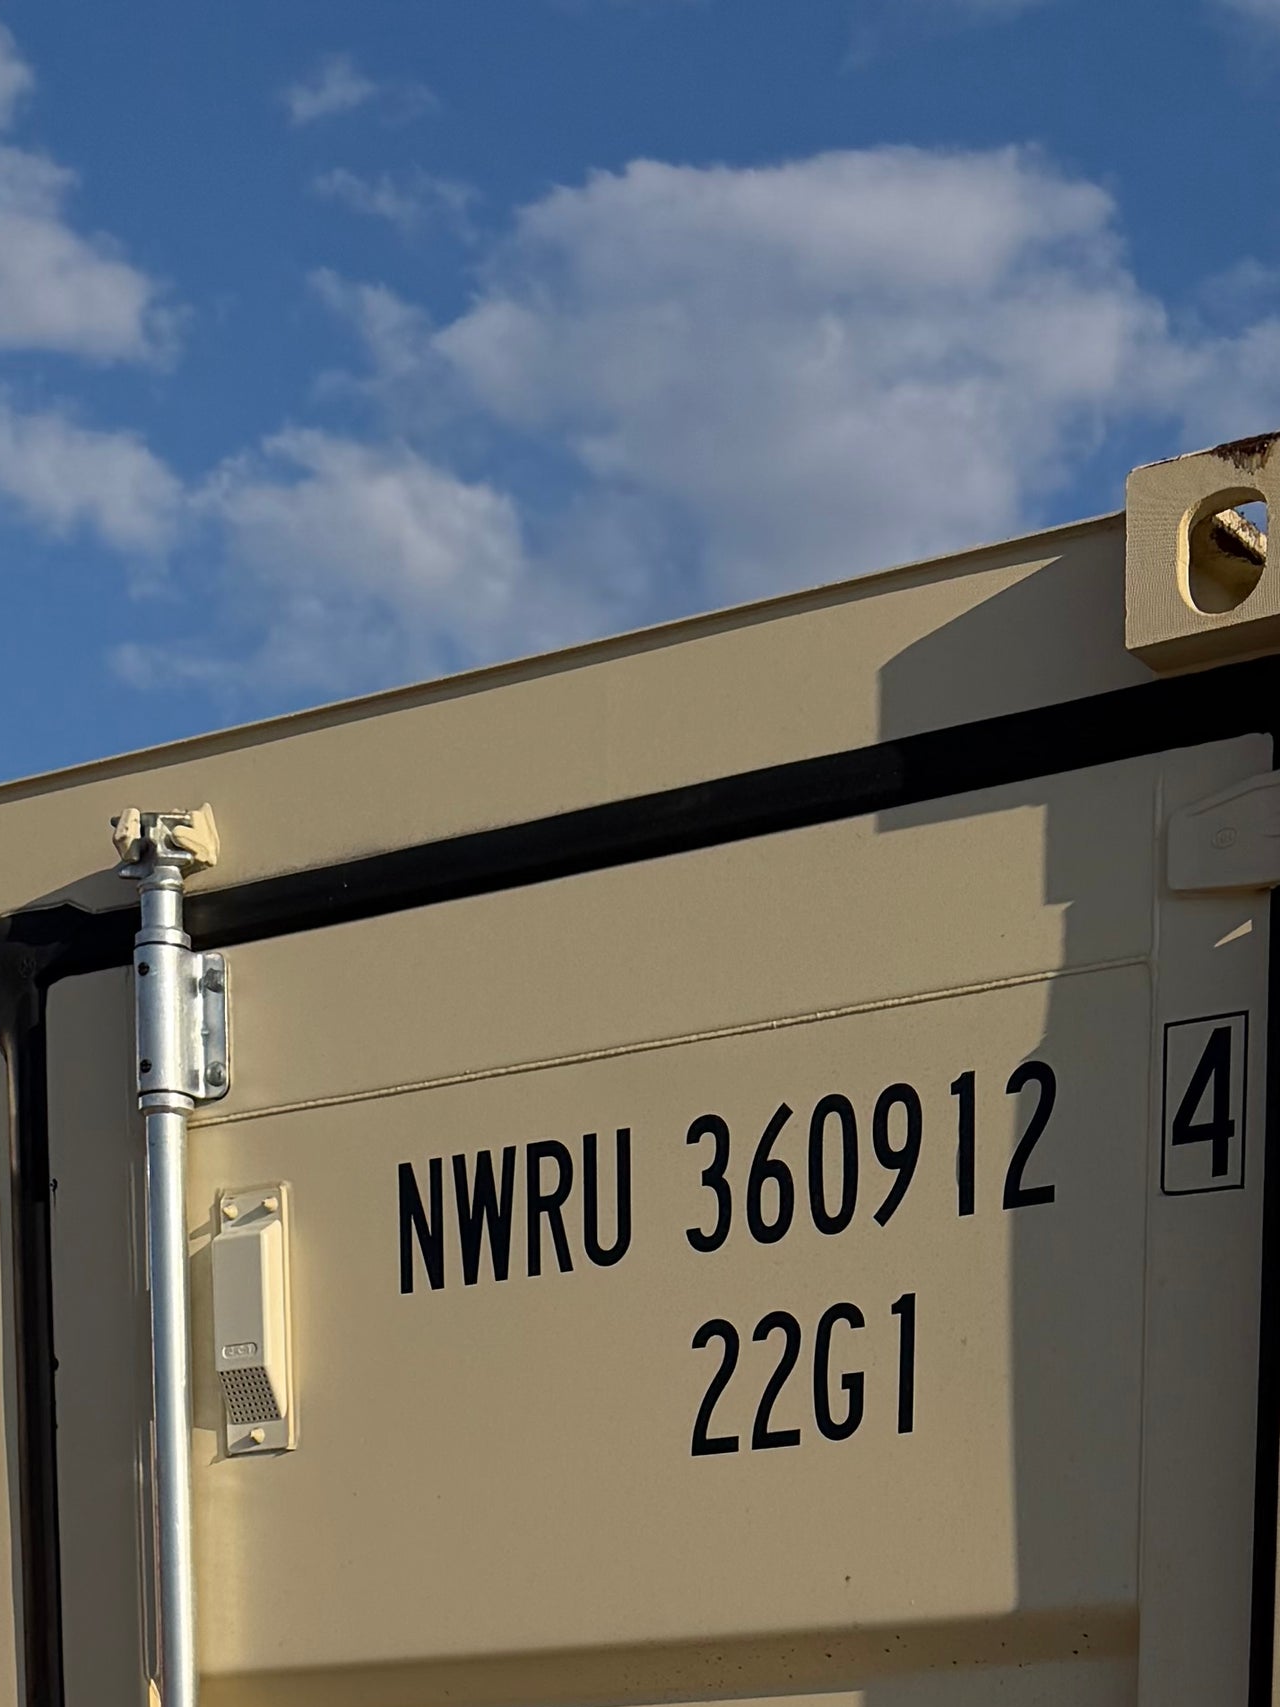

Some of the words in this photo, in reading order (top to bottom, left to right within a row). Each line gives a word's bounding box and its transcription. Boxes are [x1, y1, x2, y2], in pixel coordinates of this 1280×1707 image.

[397, 1126, 632, 1294] NWRU
[685, 1060, 1058, 1253] 360912
[1170, 1025, 1236, 1178] 4
[690, 1292, 917, 1457] 22G1
